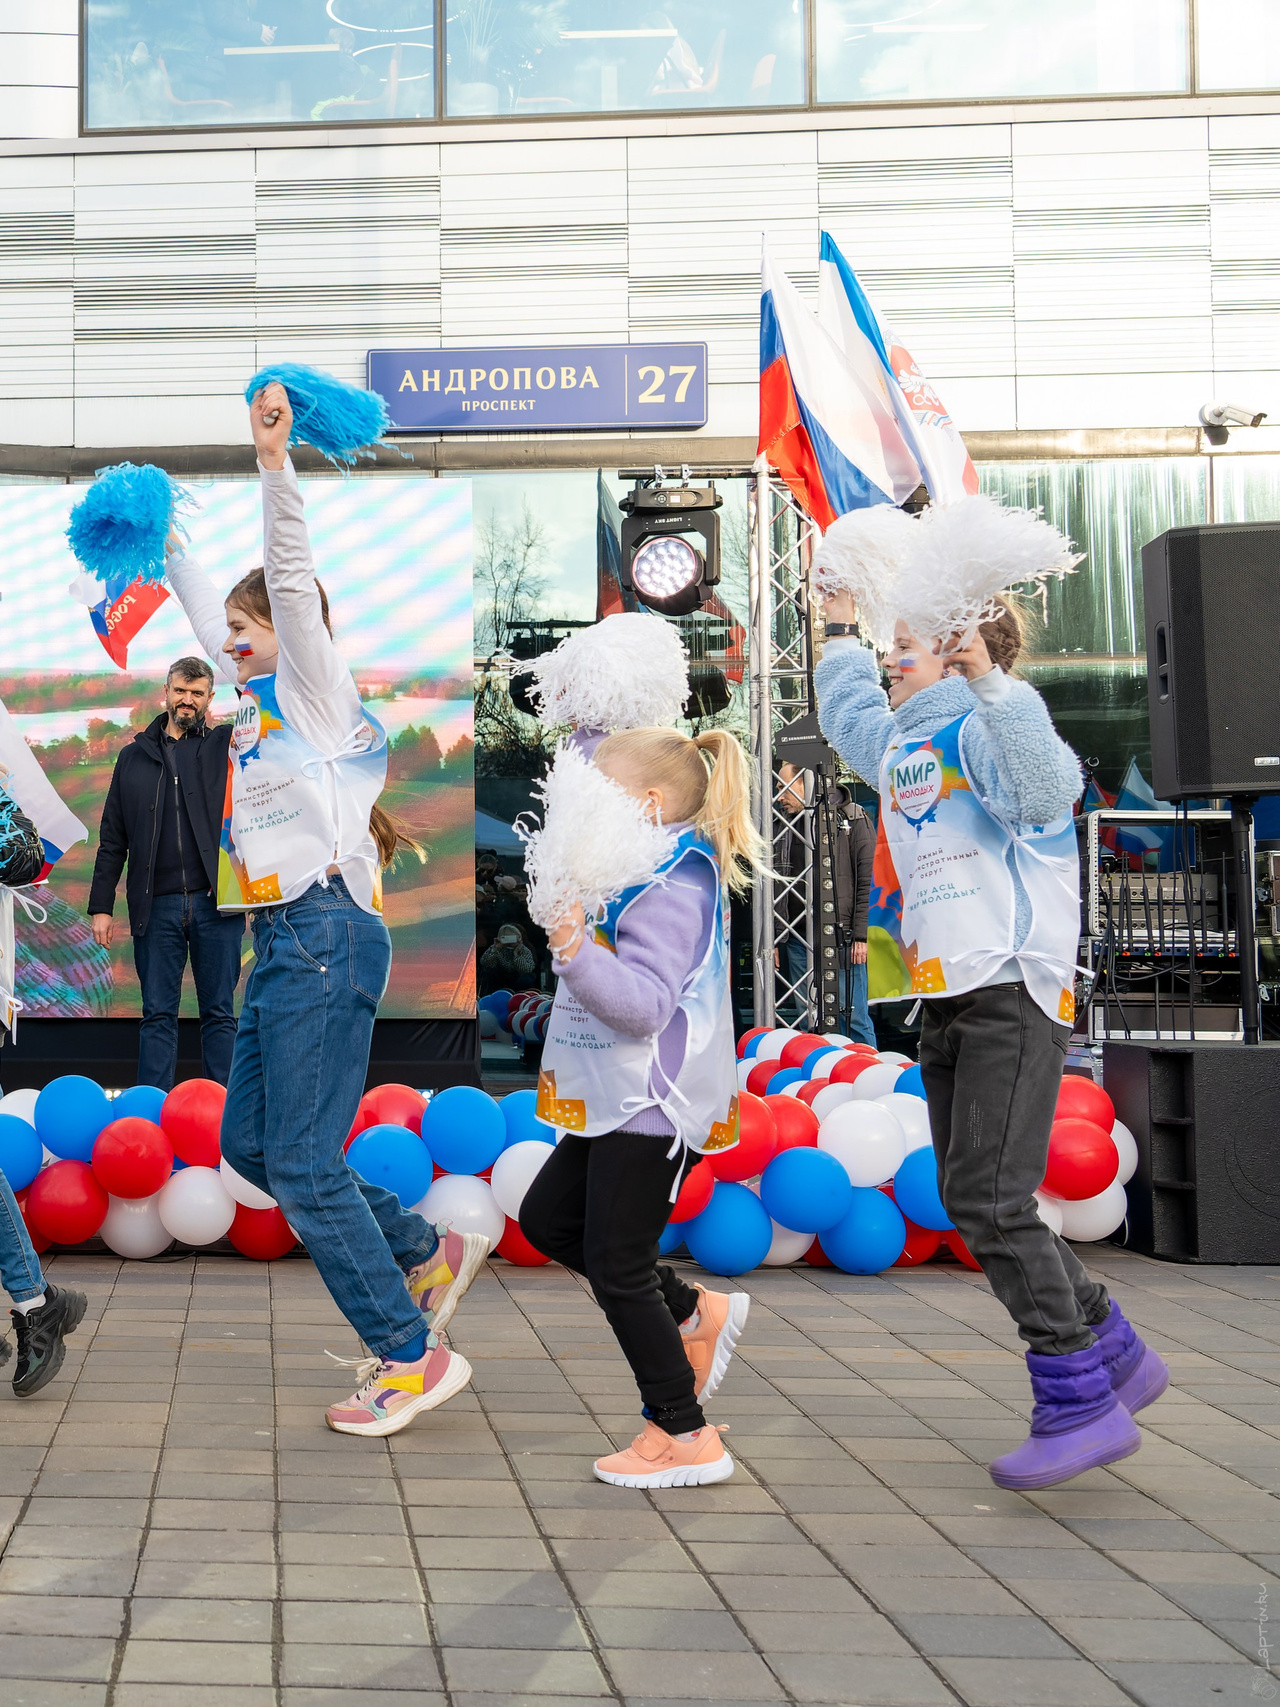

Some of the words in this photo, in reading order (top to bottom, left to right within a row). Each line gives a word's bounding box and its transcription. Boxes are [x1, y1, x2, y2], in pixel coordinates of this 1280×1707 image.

[398, 366, 600, 395] АНДРОПОВА
[637, 365, 697, 404] 27
[461, 399, 536, 412] ПРОСПЕКТ
[896, 761, 936, 788] МИР
[246, 781, 270, 793] Южный
[252, 797, 273, 808] округ
[250, 816, 264, 824] ГБУ
[267, 809, 285, 820] ДСЦ
[920, 867, 943, 879] округ
[931, 883, 955, 894] ДСЦ
